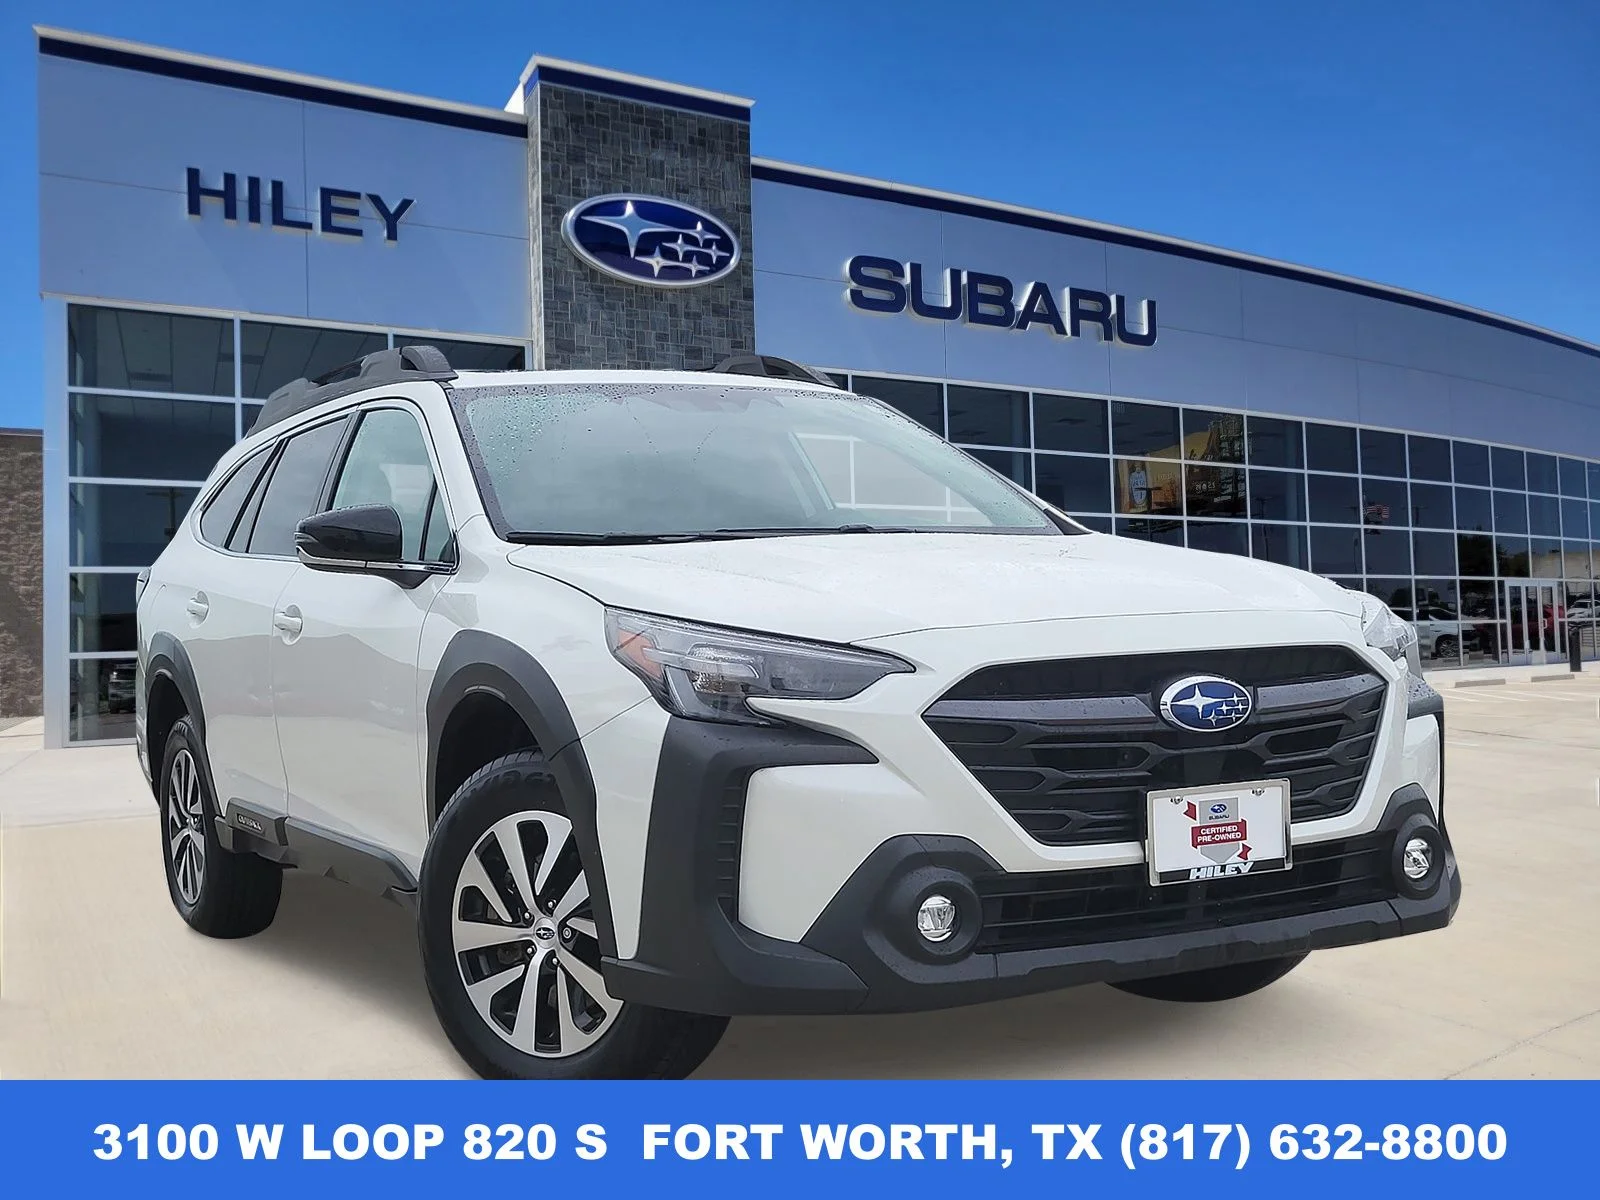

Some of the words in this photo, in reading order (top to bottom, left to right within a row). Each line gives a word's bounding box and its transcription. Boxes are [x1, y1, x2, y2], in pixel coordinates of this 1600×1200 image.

[186, 166, 416, 242] HILEY
[847, 254, 1158, 347] SUBARU
[1197, 832, 1242, 843] PRE-OWNED
[1200, 825, 1238, 835] CERTIFIED
[1189, 861, 1254, 880] HILEY
